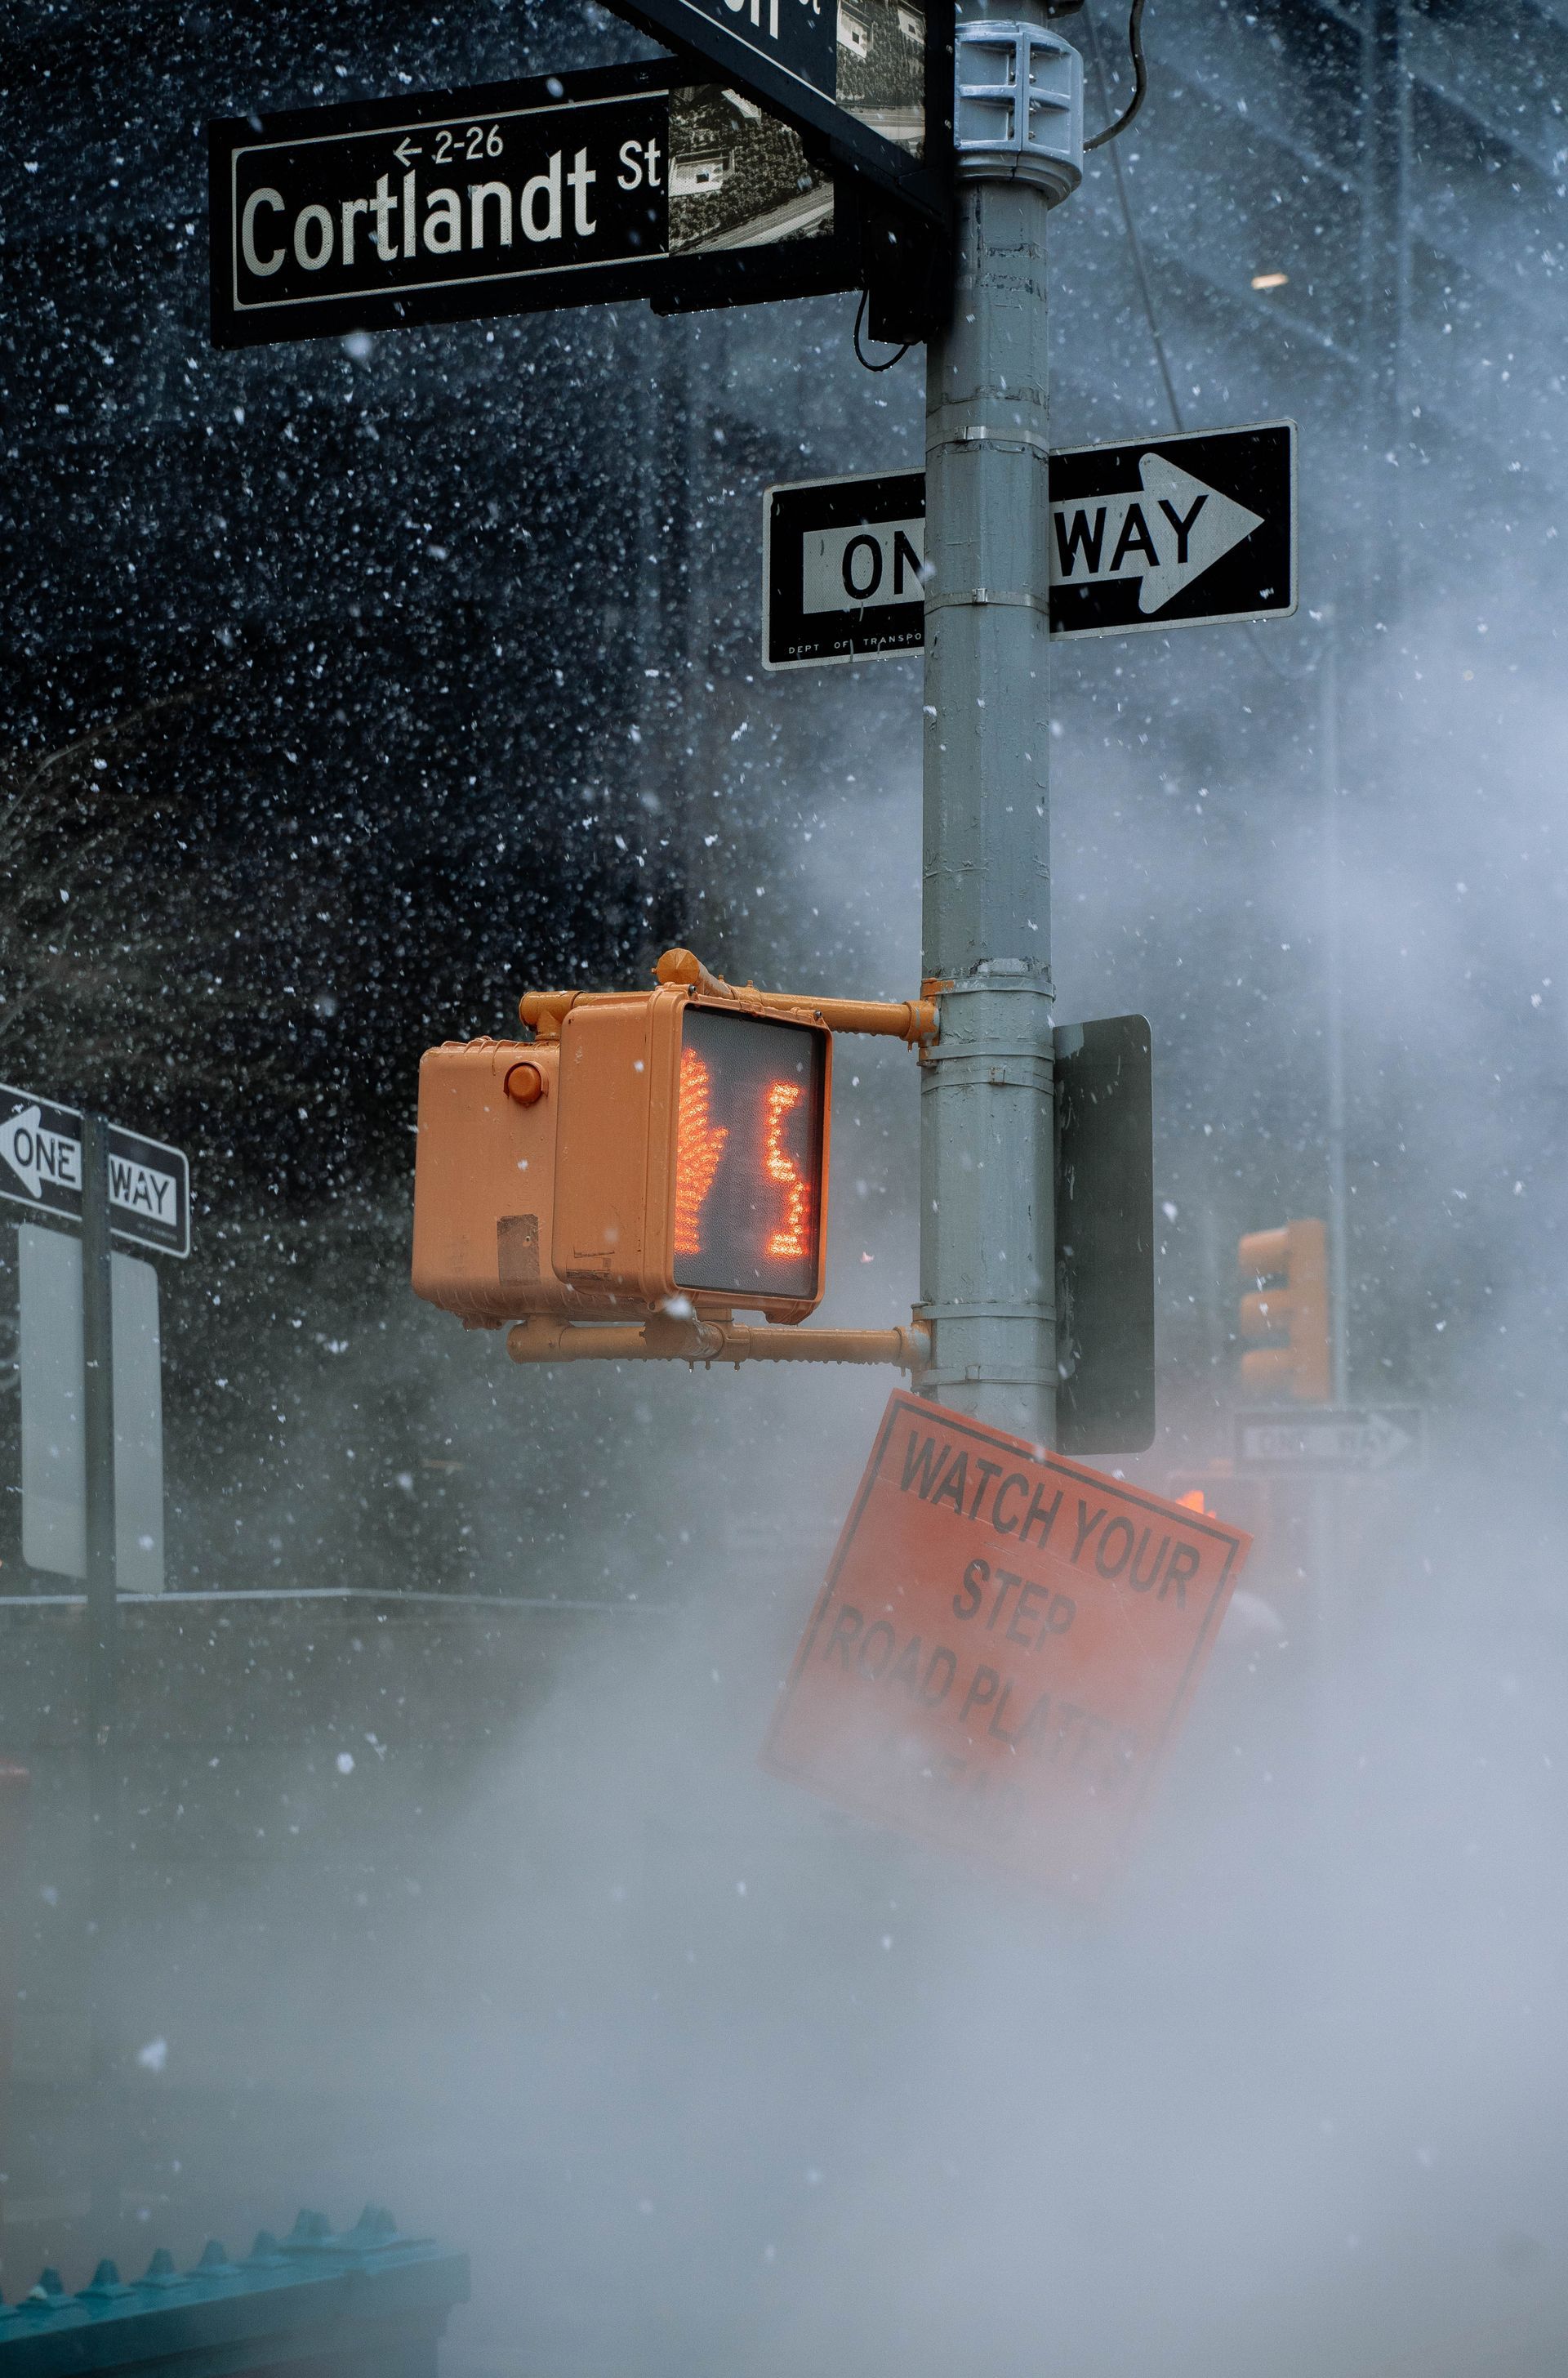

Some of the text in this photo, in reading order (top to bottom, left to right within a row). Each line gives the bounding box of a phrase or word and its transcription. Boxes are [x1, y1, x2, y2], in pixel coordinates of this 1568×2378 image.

[434, 124, 504, 164] 2-26
[241, 137, 661, 277] Cortlandt St
[841, 493, 1209, 600] ON WAY
[789, 632, 922, 654] DEPT OF TRANSPO
[13, 1127, 169, 1215] ONE WAY
[900, 1430, 1200, 1610] WATCH YOUR
[953, 1559, 1076, 1652] STEP
[823, 1604, 957, 1709] ROAD
